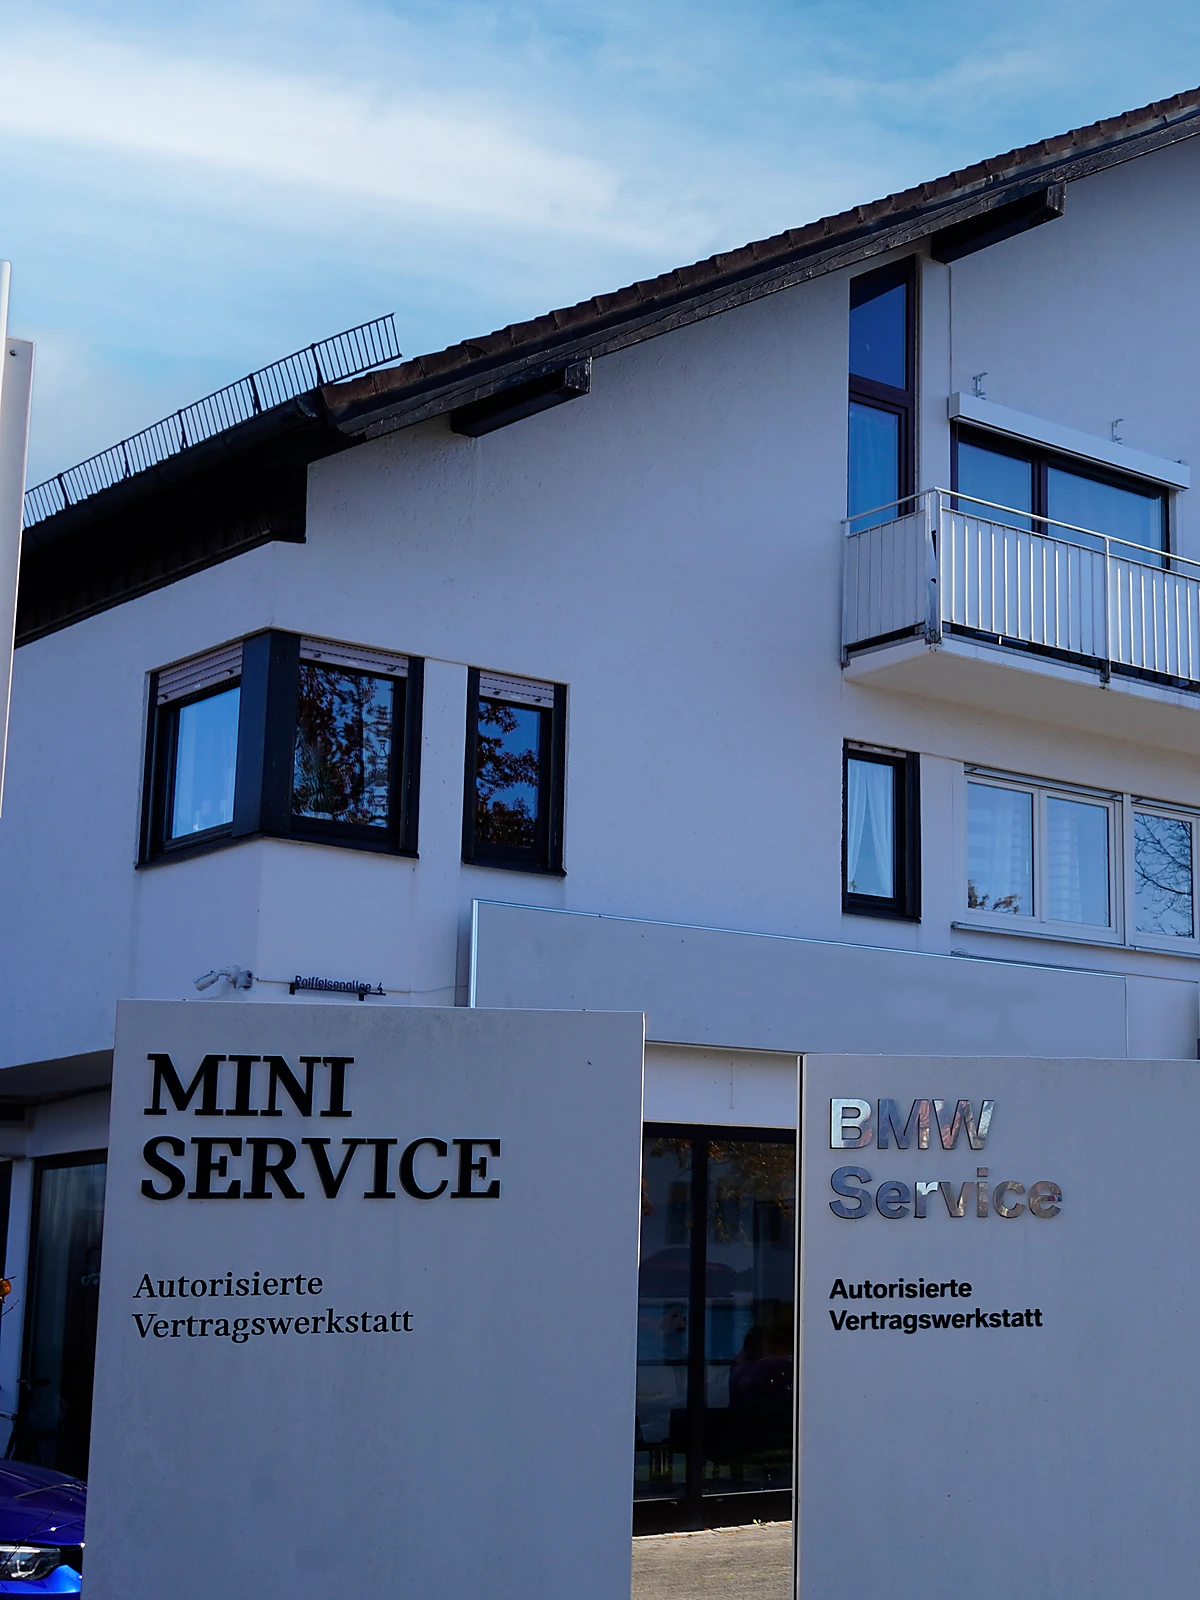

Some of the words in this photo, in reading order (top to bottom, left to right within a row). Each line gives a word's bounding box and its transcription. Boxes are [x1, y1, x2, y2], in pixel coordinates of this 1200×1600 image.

[143, 1053, 355, 1118] MINI
[829, 1098, 995, 1150] BMW
[140, 1135, 501, 1201] SERVICE
[828, 1165, 1063, 1219] Service
[132, 1271, 323, 1299] Autorisierte
[829, 1278, 973, 1299] Autorisierte
[132, 1308, 414, 1344] Vertragswerkstatt
[829, 1308, 1044, 1334] Vertragswerkstatt
